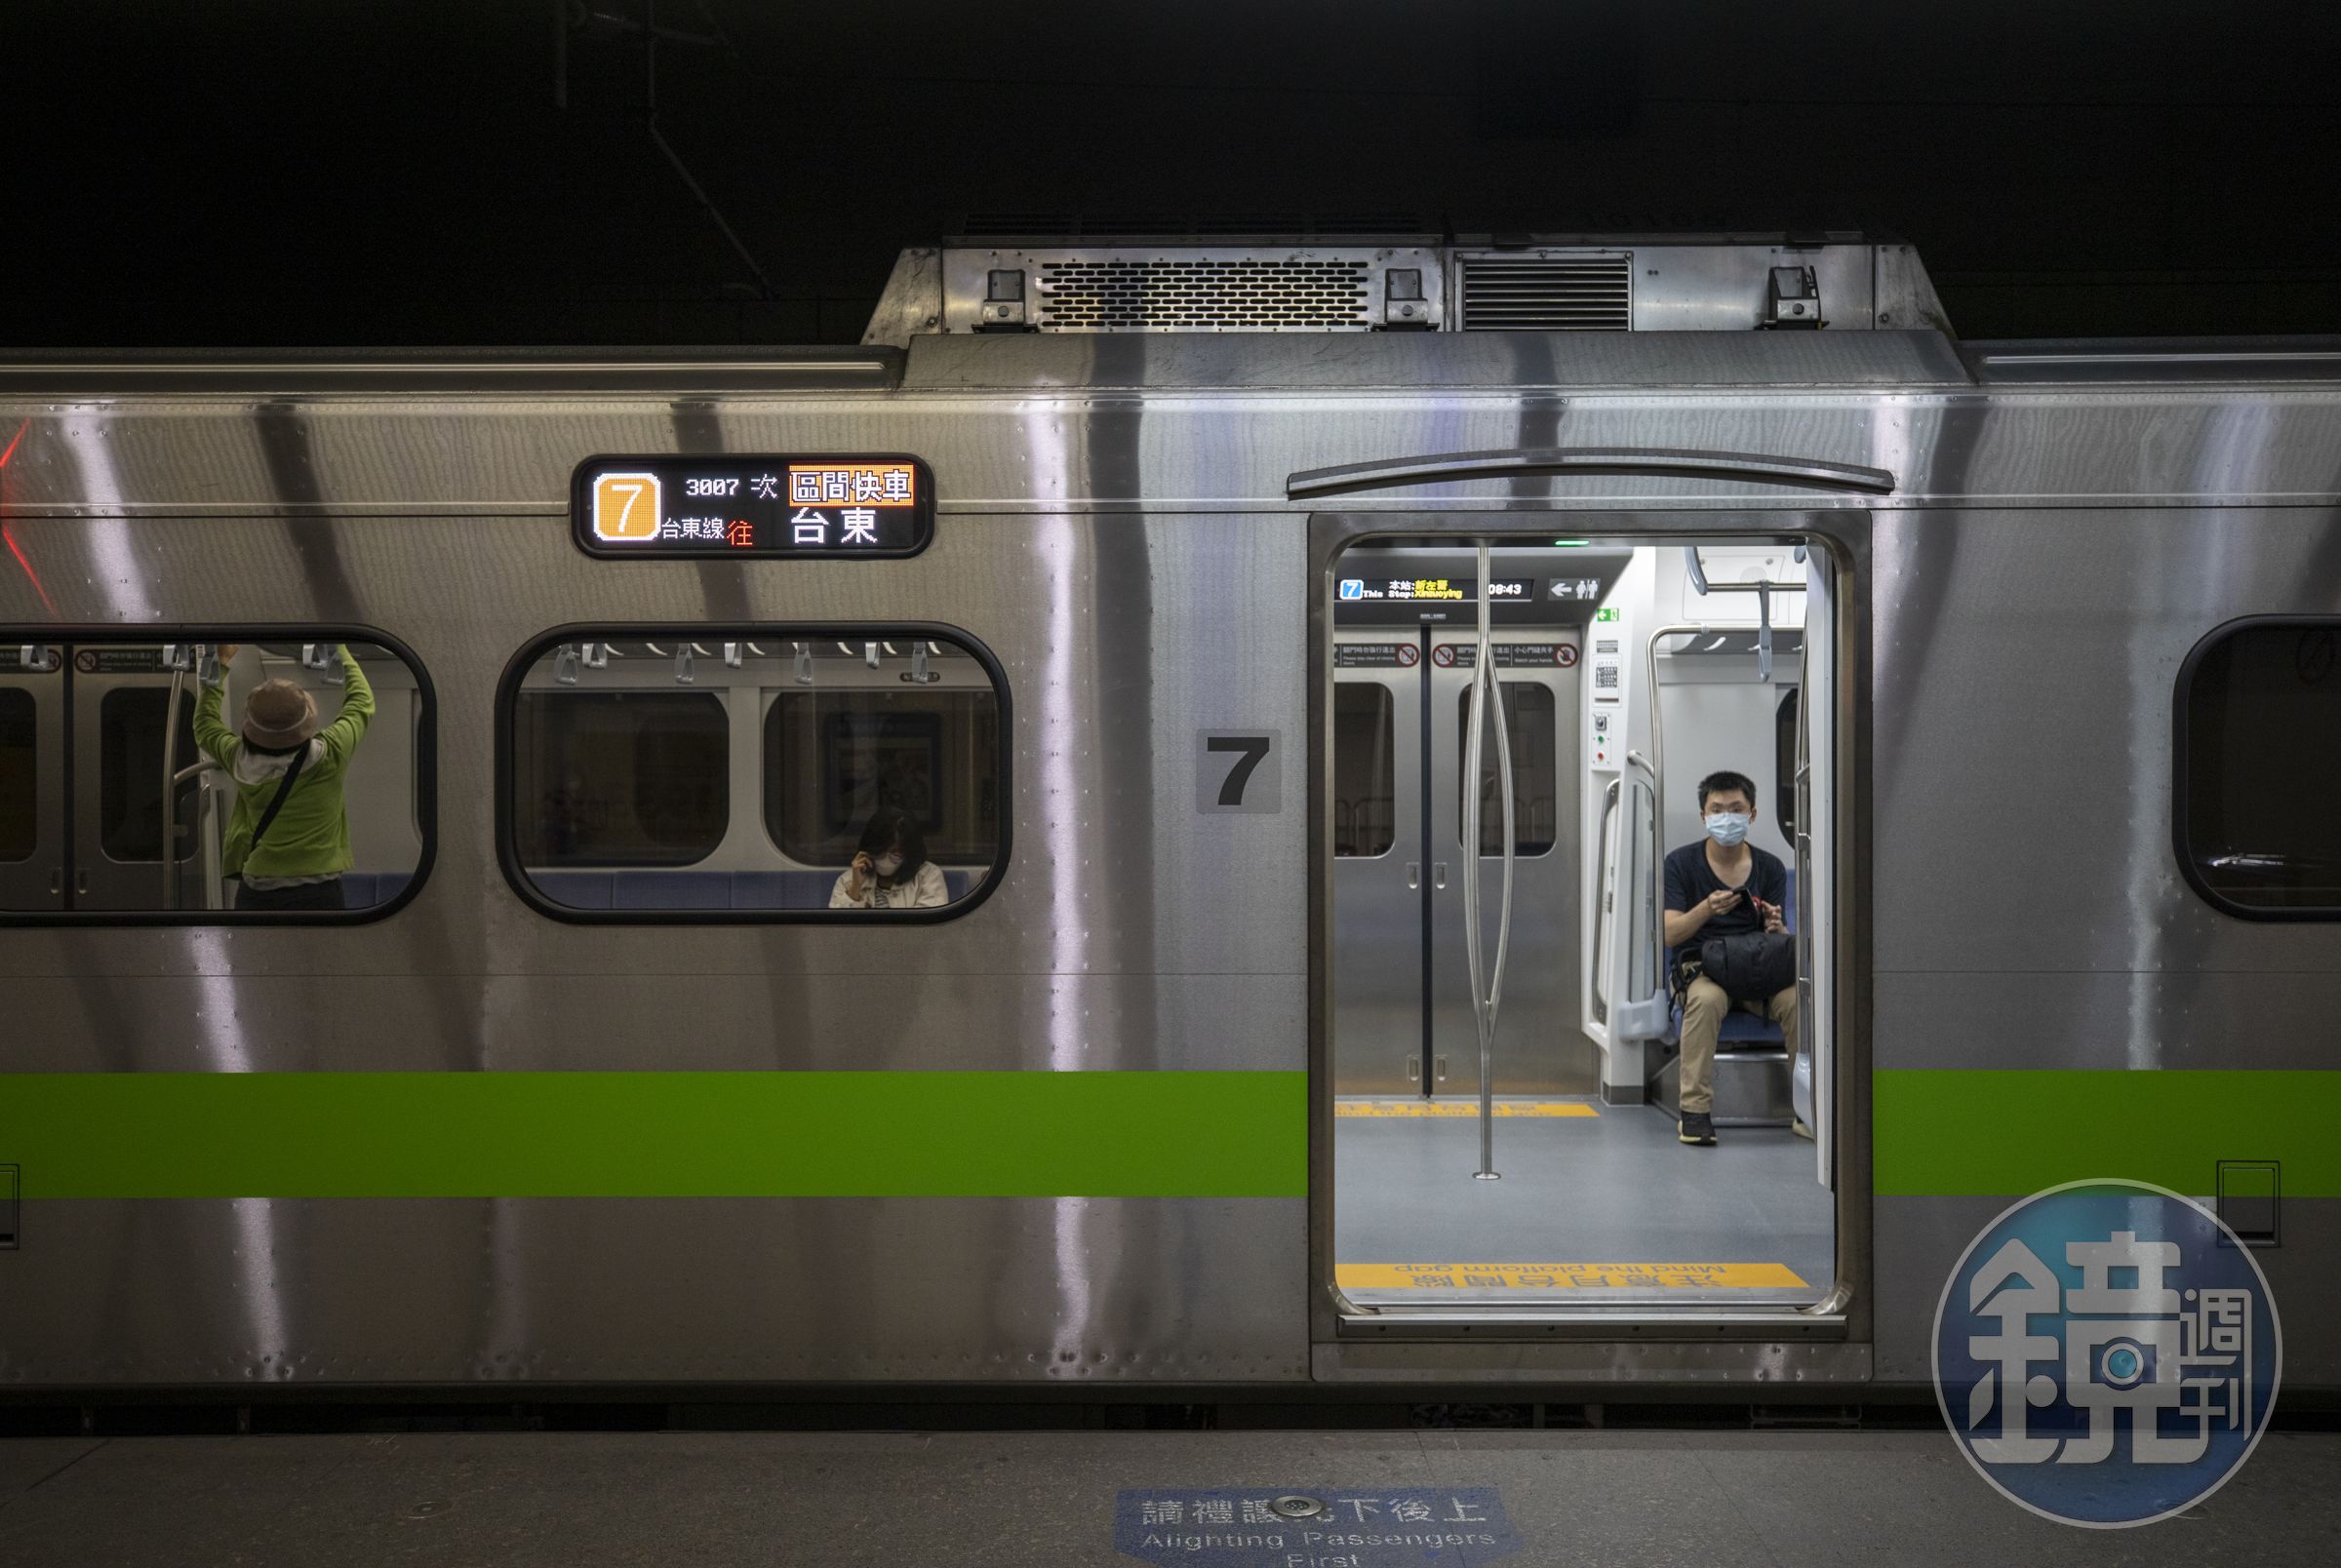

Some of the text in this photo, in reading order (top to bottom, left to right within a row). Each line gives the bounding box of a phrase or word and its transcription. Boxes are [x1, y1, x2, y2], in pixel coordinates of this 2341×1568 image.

[686, 474, 777, 499] 3007 次
[791, 469, 912, 502] 區間快車
[612, 484, 643, 533] 7
[791, 507, 878, 544] 台東
[1346, 581, 1360, 599] 7
[1488, 584, 1523, 595] 08:43
[1208, 737, 1270, 805] 7
[1394, 1264, 1726, 1274] Mind the platform gap
[1141, 1498, 1487, 1525] 請禮讓下後上
[1141, 1532, 1496, 1550] Alighting Passengers
[1287, 1553, 1359, 1568] First
